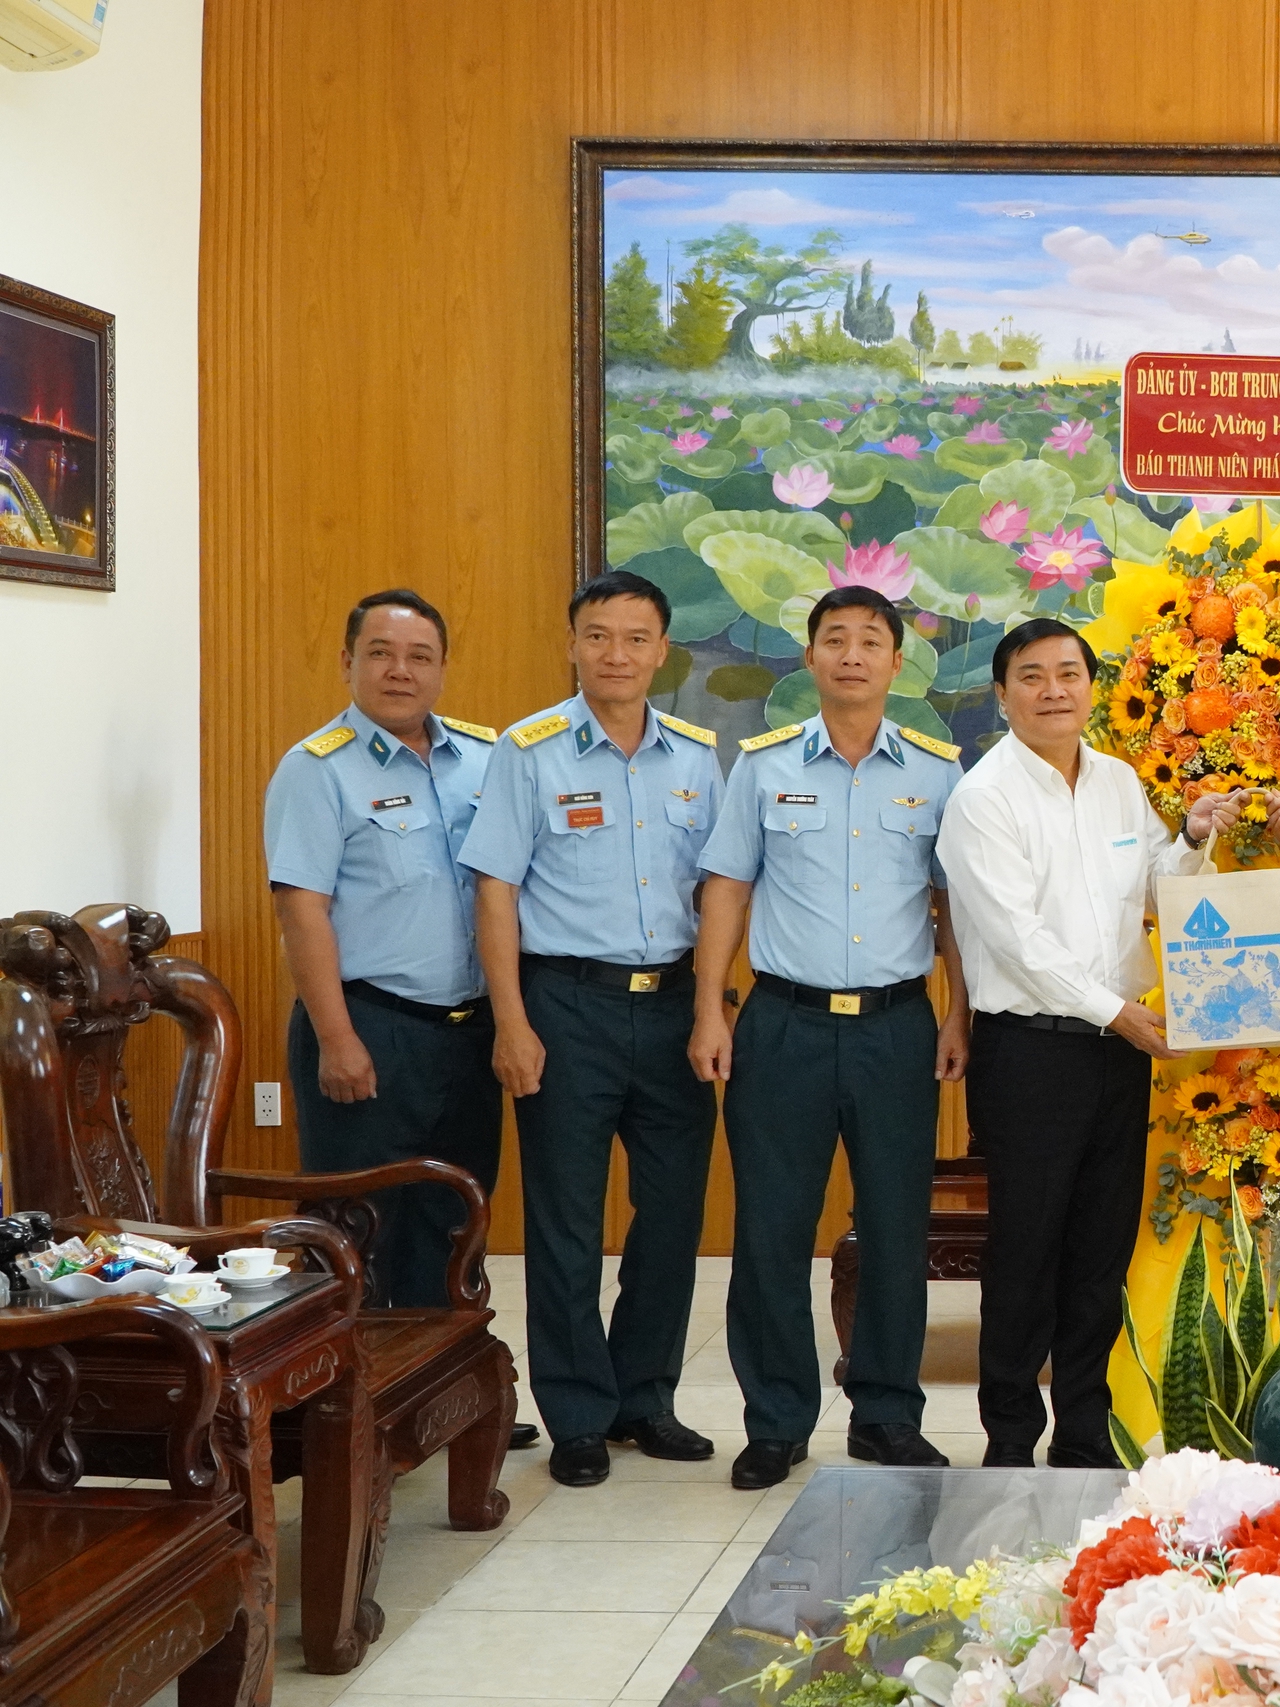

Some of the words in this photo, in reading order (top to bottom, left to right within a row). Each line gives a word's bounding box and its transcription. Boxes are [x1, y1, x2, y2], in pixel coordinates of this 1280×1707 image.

[1136, 361, 1175, 396] ĐẢNG
[1178, 362, 1198, 396] ỦY
[1209, 371, 1238, 398] BCH
[1157, 410, 1206, 434] Chúc
[1210, 412, 1266, 442] Mừng
[1136, 449, 1163, 476] BÁO
[1167, 455, 1214, 478] THANH
[1217, 451, 1249, 478] NIÊN
